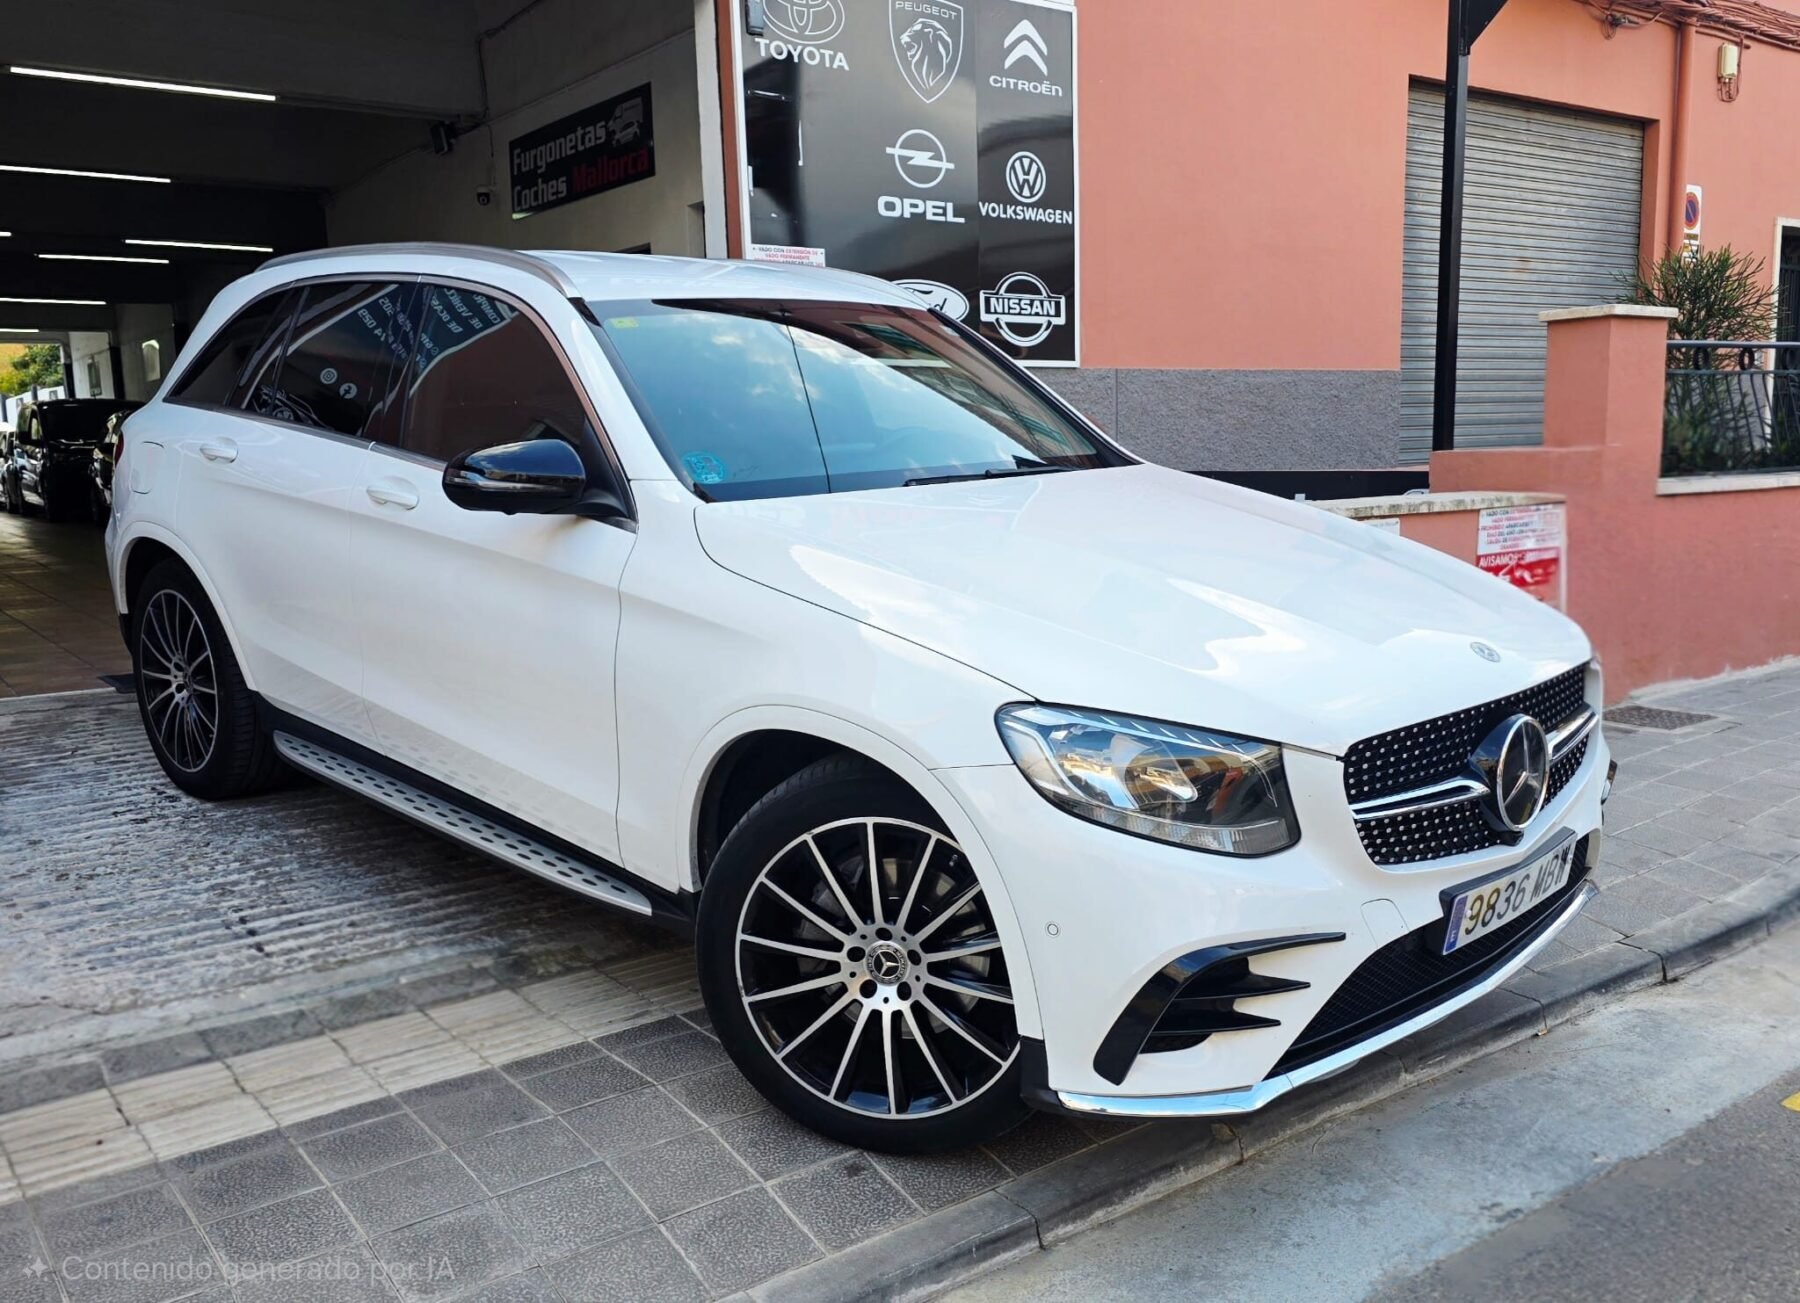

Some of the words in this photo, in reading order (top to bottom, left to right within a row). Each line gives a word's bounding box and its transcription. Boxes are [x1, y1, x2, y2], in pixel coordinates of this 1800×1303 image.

[895, 1, 958, 20] PEUGEOT
[754, 37, 850, 71] TOYOTA
[513, 120, 606, 175] Furgonetas
[513, 175, 567, 212] Coches
[571, 146, 650, 193] Mallorca
[877, 195, 965, 223] OPEL
[979, 201, 1073, 224] VOLKSWAGEN
[989, 297, 1056, 317] NISSAN
[1464, 873, 1531, 936] 9836
